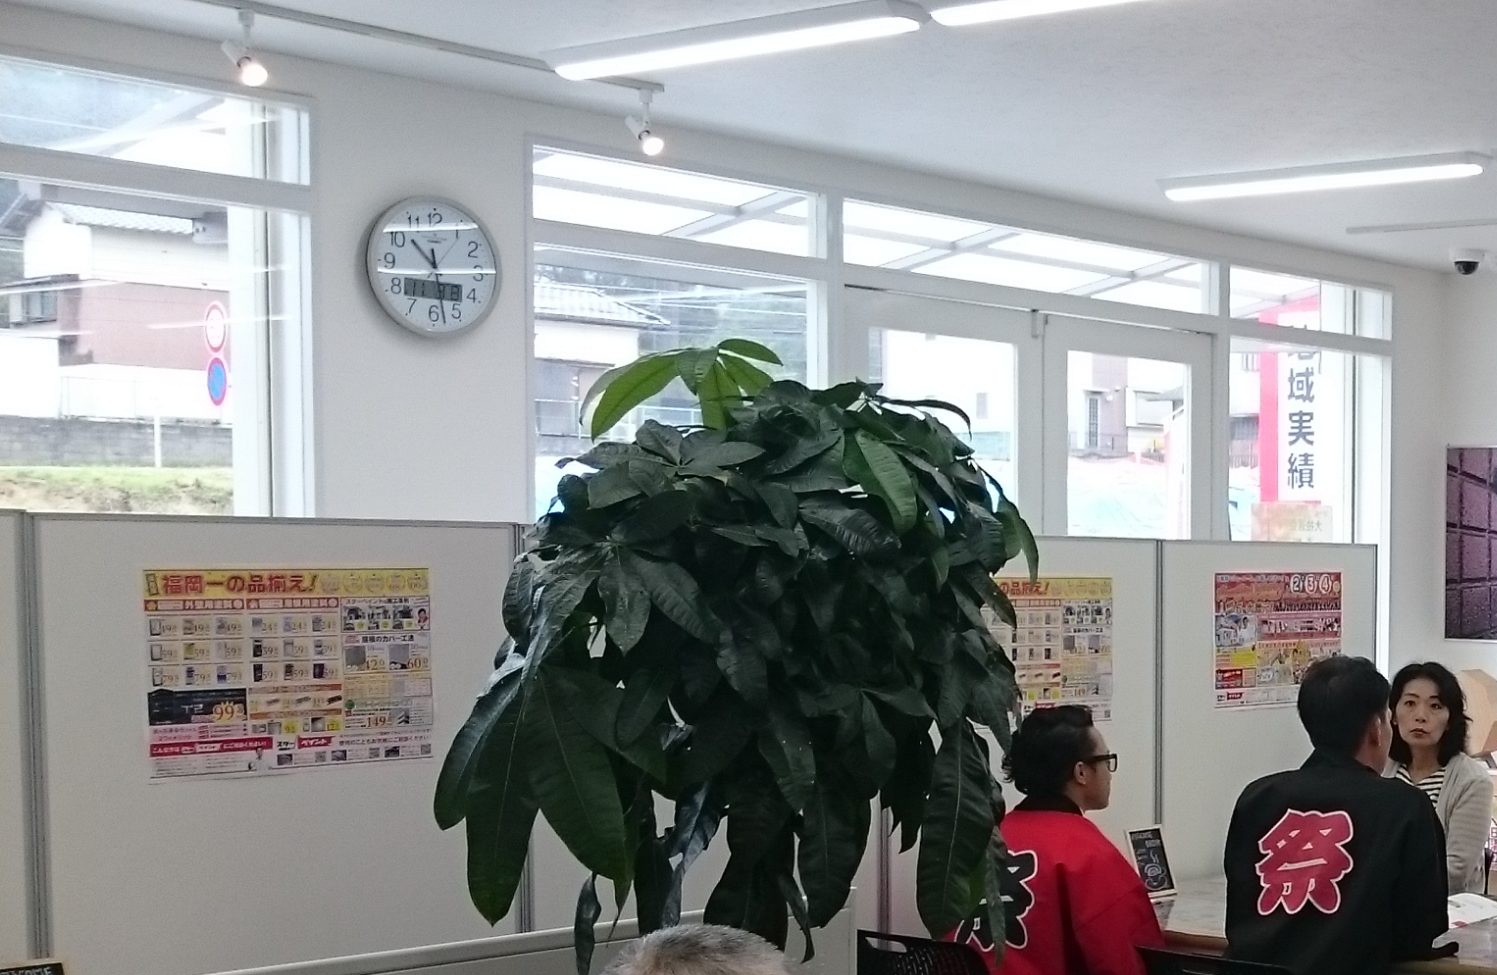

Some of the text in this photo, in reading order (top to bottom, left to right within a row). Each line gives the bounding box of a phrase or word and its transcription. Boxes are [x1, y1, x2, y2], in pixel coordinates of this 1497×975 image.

[390, 230, 405, 248] 10
[467, 240, 479, 258] 2
[383, 252, 396, 269] 9
[473, 265, 484, 282] 3
[390, 277, 402, 294] 8
[466, 287, 477, 303] 4
[407, 297, 417, 313] 7
[428, 304, 439, 322] 6
[451, 303, 462, 319] 5
[1255, 808, 1354, 916] 祭
